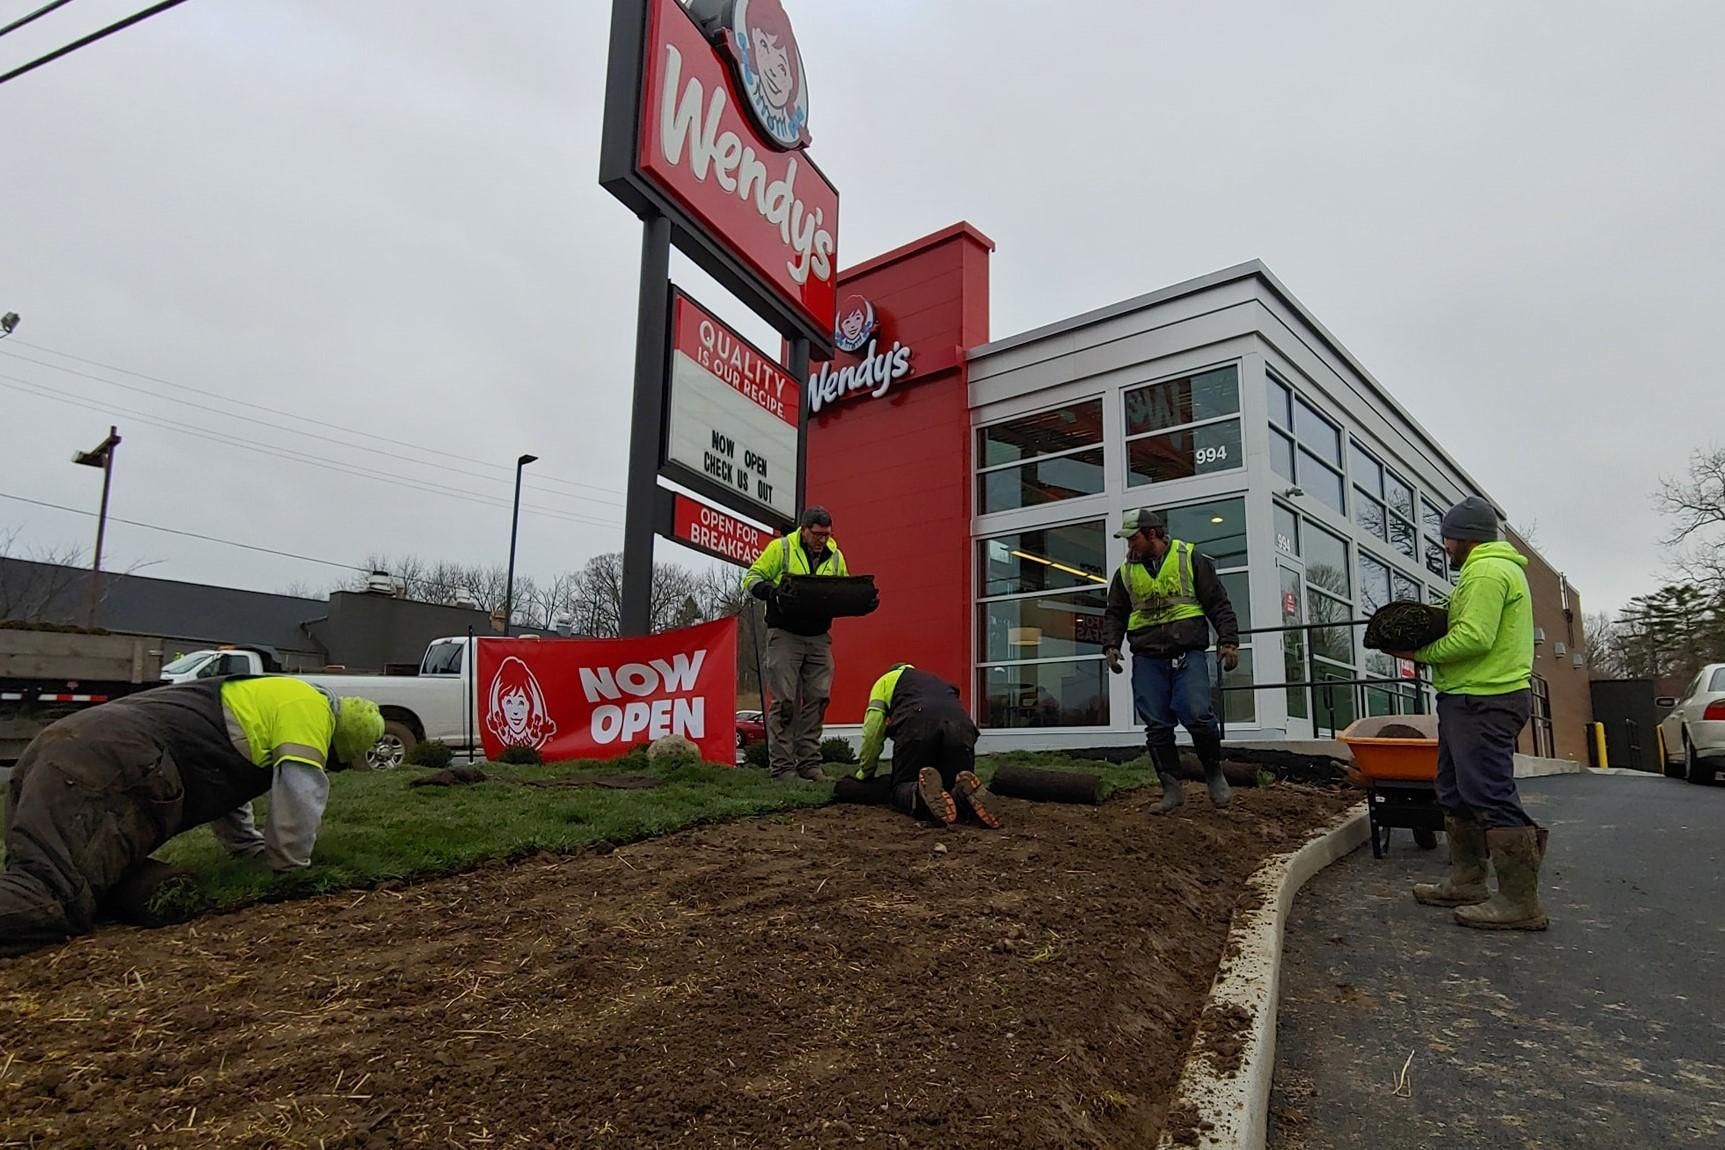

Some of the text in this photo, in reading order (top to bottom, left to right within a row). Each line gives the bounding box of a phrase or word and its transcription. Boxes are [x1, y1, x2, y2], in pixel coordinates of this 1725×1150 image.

[659, 43, 833, 285] Wendy's
[698, 346, 710, 367] IS
[713, 359, 741, 390] OUR
[699, 320, 786, 399] QUALITY
[704, 451, 773, 504] CHECK US OUT
[711, 429, 767, 479] NOW OPEN
[1195, 445, 1227, 465] 994
[690, 522, 763, 564] BREAKFAS
[700, 507, 759, 547] OPEN FOR
[578, 649, 707, 703] NOW
[590, 697, 705, 744] OPEN
